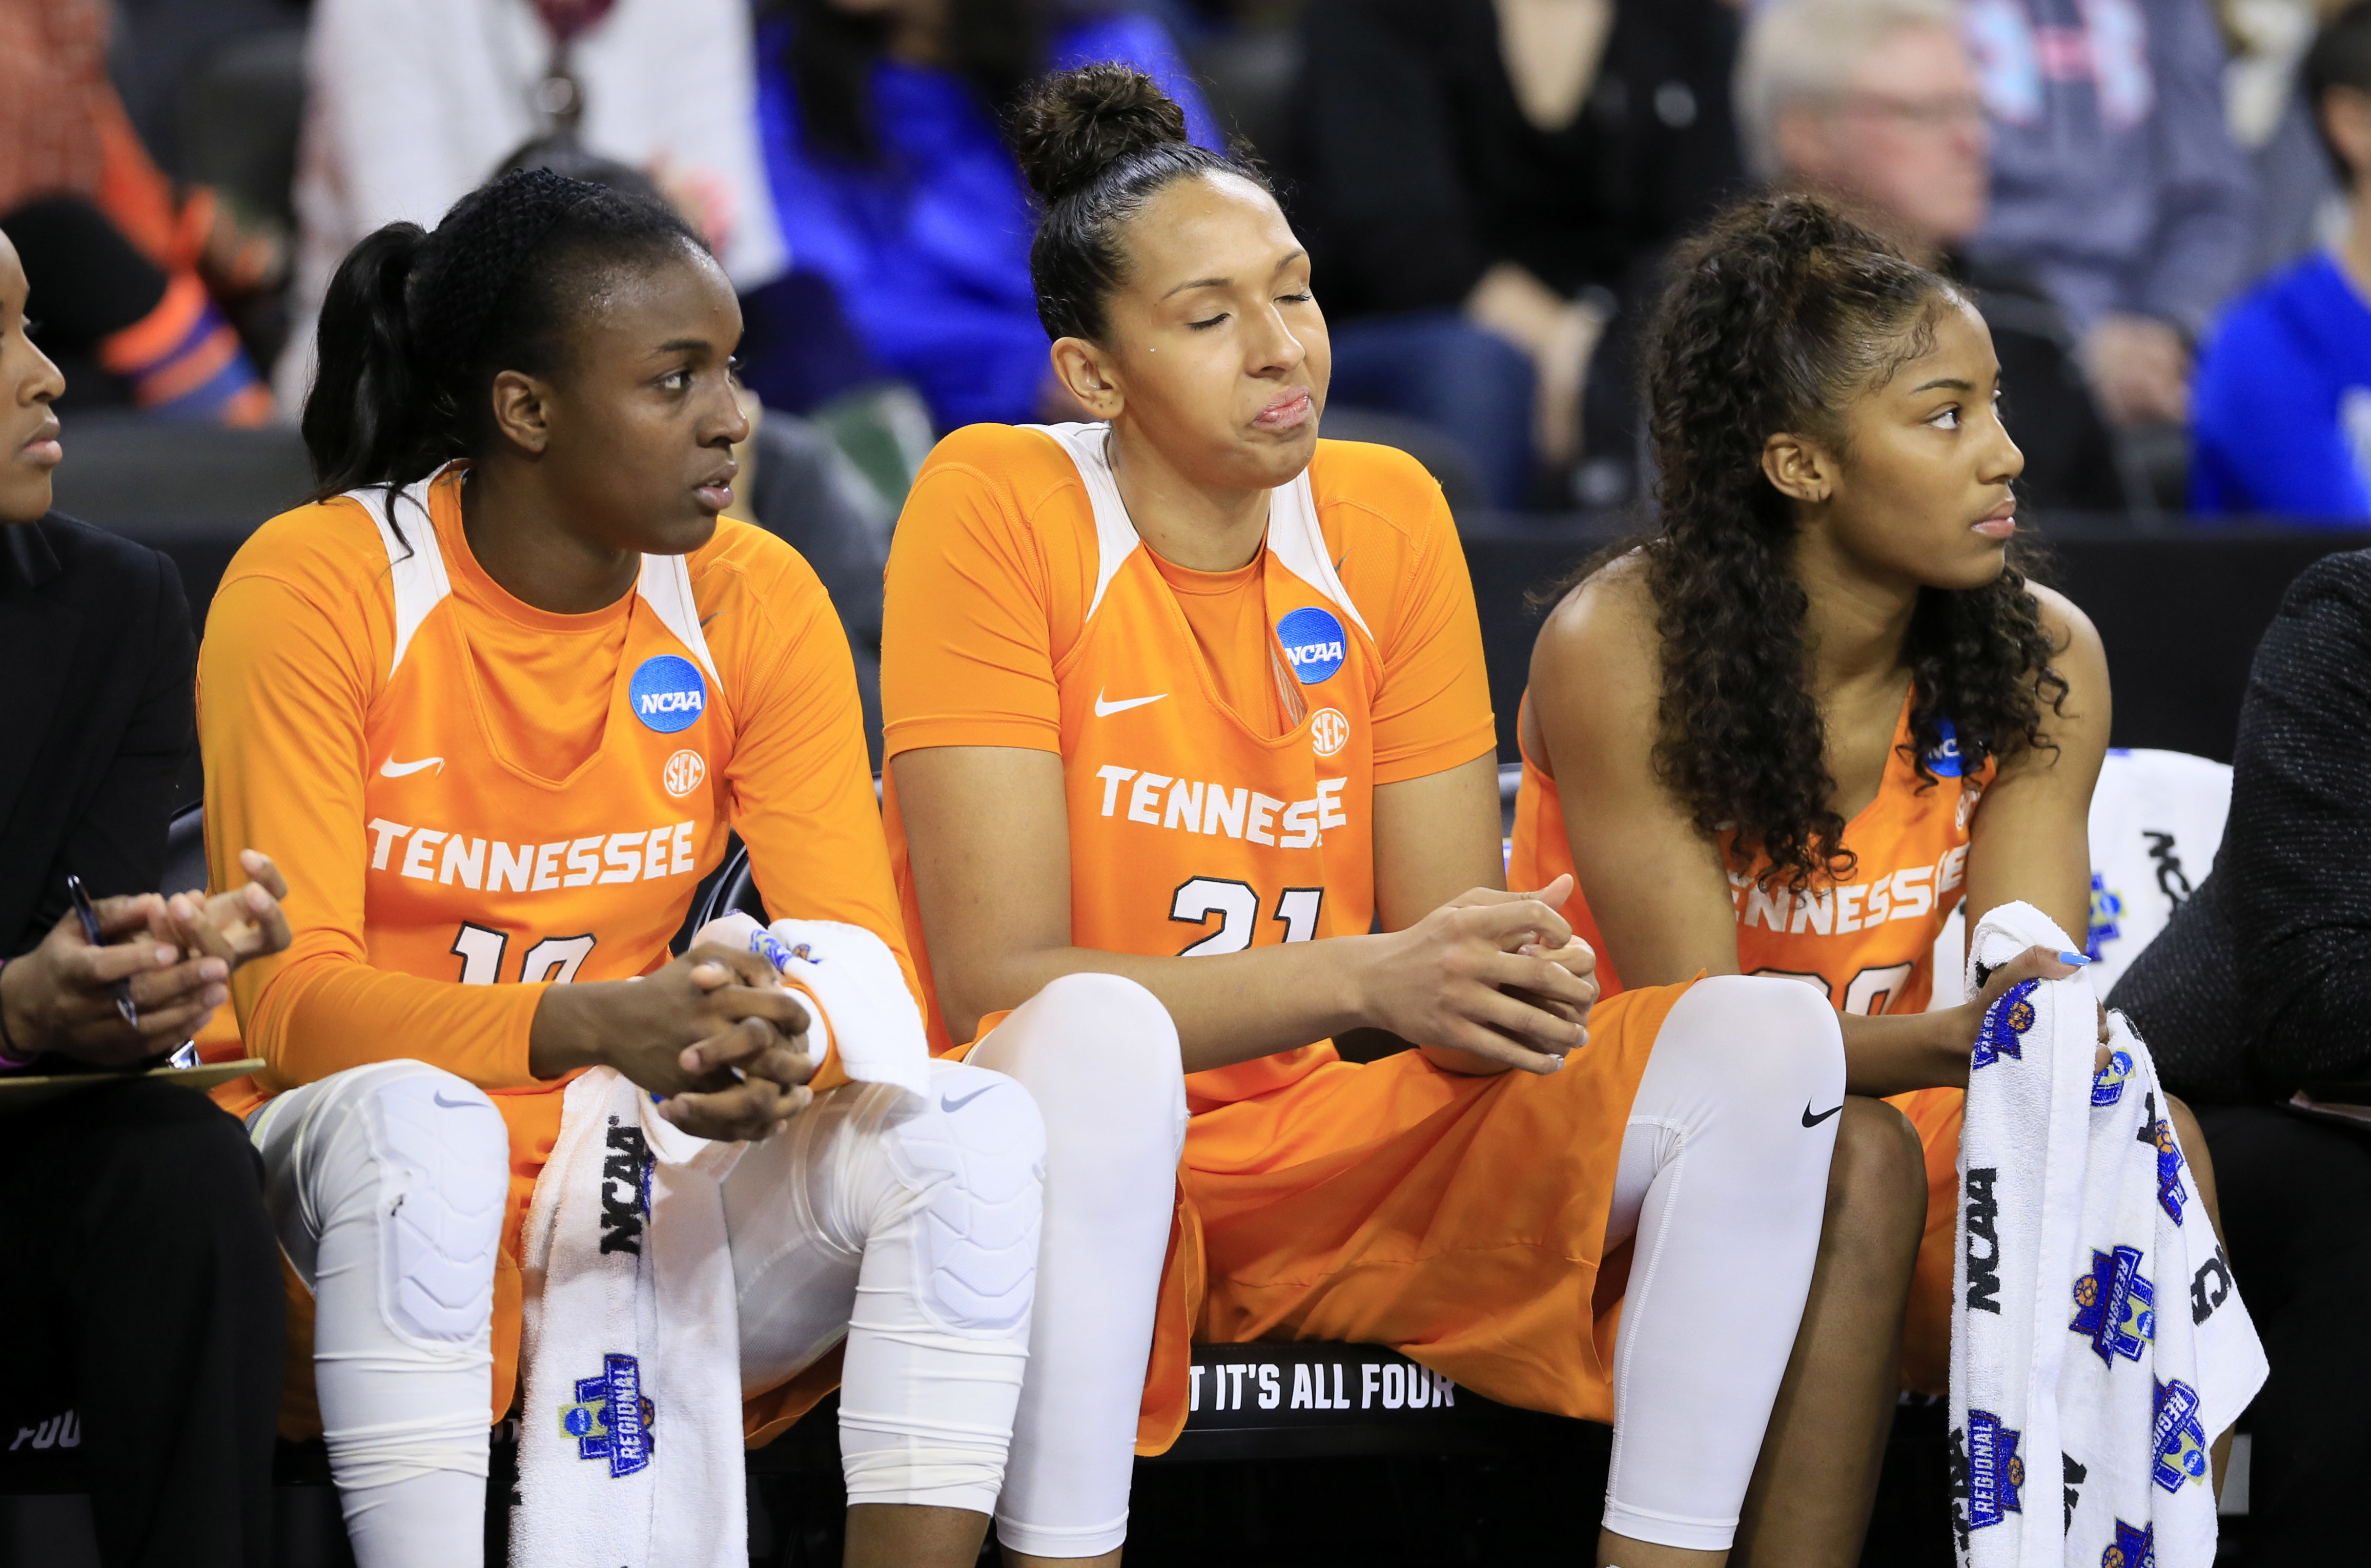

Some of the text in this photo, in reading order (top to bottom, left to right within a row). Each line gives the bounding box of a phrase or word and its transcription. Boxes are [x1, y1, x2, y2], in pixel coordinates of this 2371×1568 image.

[1282, 641, 1344, 666] NCAA
[641, 690, 702, 714] NCAA
[1313, 712, 1345, 750] SEC
[667, 757, 701, 793] SEC
[367, 817, 694, 893] TENNESSEE
[1169, 875, 1324, 957] 21
[600, 1126, 646, 1255] NCAA
[1967, 1168, 2000, 1316] NCAA
[2102, 1257, 2129, 1350] REGIONAL
[615, 1366, 642, 1460] REGIONAL
[1215, 1364, 1280, 1411] IT'S
[1290, 1364, 1350, 1409] ALL
[1361, 1364, 1455, 1409] FOUR
[1973, 1423, 1994, 1514] REGIONAL
